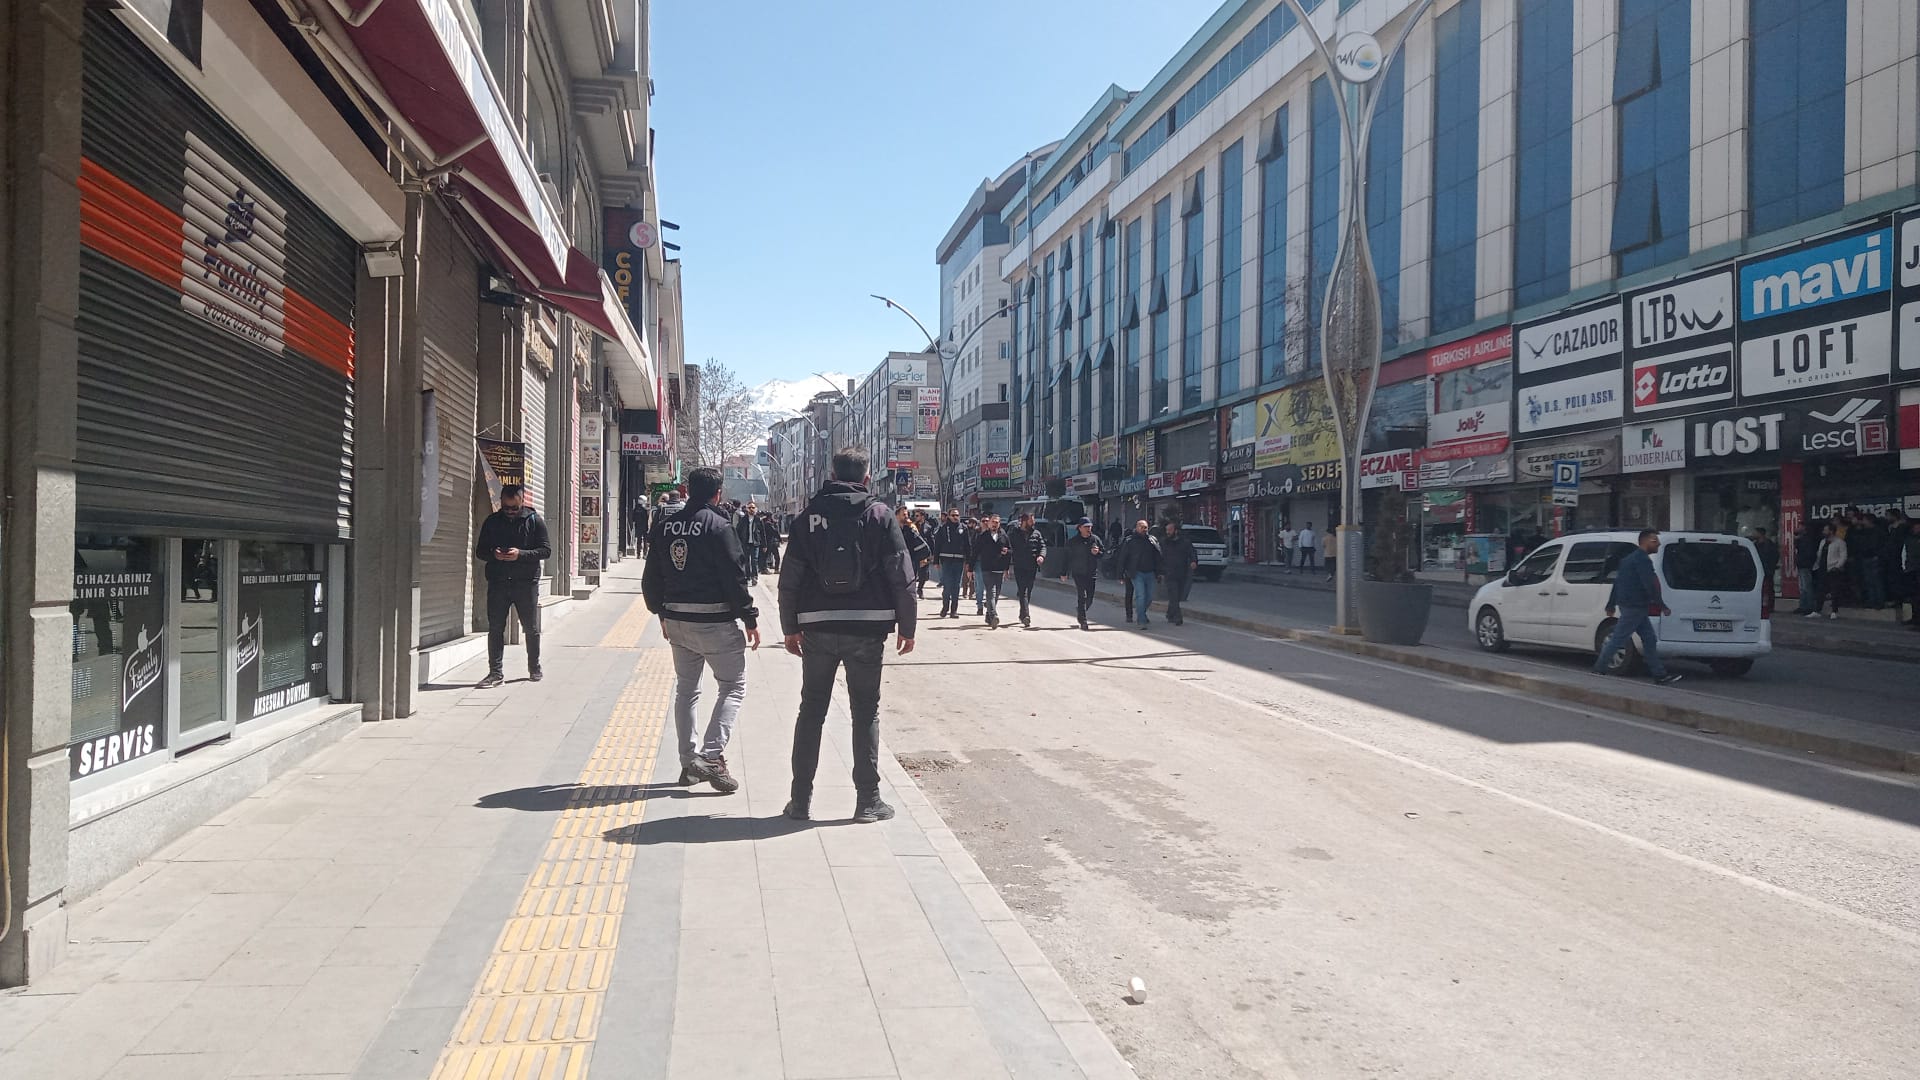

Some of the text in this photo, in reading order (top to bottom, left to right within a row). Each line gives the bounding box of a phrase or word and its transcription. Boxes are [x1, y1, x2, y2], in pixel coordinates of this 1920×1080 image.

[1753, 233, 1881, 315] mavi
[1639, 293, 1677, 345] LTB
[1553, 318, 1618, 356] CAZADOR
[1773, 323, 1858, 377] LOFT
[1431, 345, 1471, 367] TURKISH
[1659, 364, 1728, 394] lotto
[1544, 399, 1562, 413] U.S.
[1565, 394, 1587, 409] POLO
[1590, 389, 1617, 405] ASSN.
[1457, 417, 1479, 433] Jolly
[1695, 412, 1783, 457] LOST
[1360, 452, 1411, 477] ECZANE
[1623, 449, 1683, 467] LUMBERJACK
[1561, 466, 1572, 481] D
[1811, 503, 1848, 520] LOFT
[128, 647, 159, 690] Family
[253, 690, 285, 717] AKSESUAR
